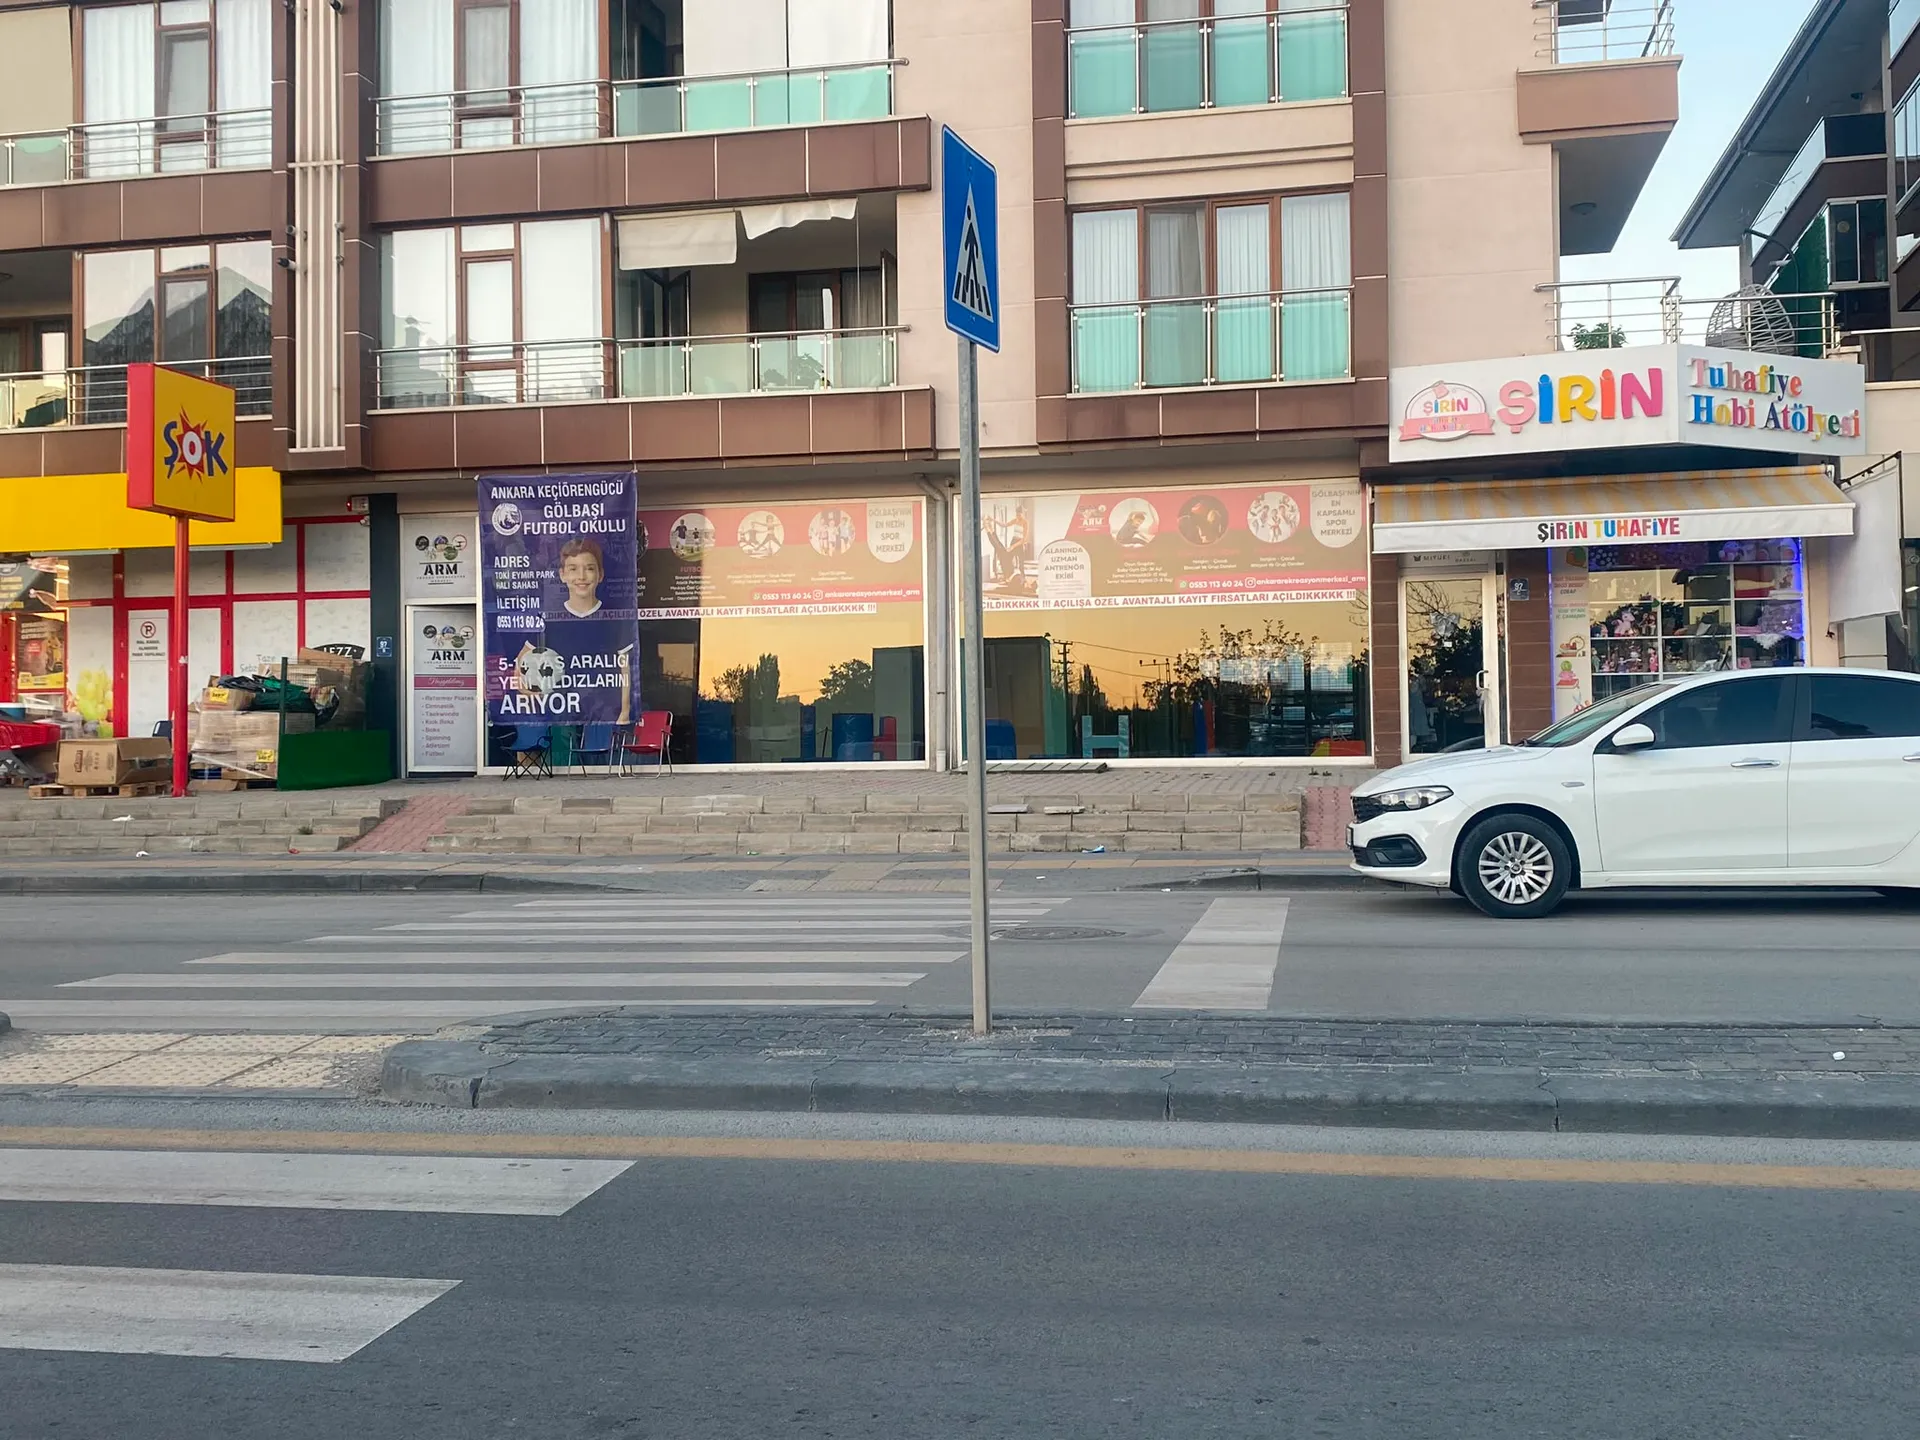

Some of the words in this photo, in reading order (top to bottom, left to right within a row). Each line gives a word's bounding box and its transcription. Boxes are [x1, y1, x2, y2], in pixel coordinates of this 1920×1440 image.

[1691, 357, 1802, 402] Tuhafiye
[1497, 368, 1663, 434] ŞİRİN
[1692, 393, 1756, 428] Hobi
[1763, 402, 1860, 441] Atölyesi
[163, 420, 228, 479] ŞOK
[491, 486, 535, 499] ANKARA
[538, 479, 624, 501] KEÇİÖRENGÜCÜ
[543, 501, 604, 521] GÖLBAŞI
[523, 521, 576, 535] FUTBOL
[580, 519, 626, 534] OKULU
[1321, 526, 1352, 536] MERKEZİ
[1537, 519, 1588, 543] ŞİRİN
[1594, 517, 1680, 539] TUHAFİYE
[880, 532, 900, 540] SPOR
[876, 543, 905, 552] MERKEZİ
[494, 556, 530, 568] ADRES
[424, 563, 458, 576] ARM
[511, 570, 535, 579] EYMİR
[536, 570, 555, 579] PARK
[512, 581, 539, 589] SAHASI
[1189, 581, 1208, 589] 0553
[1222, 580, 1233, 588] 60
[1233, 580, 1243, 588] 24
[497, 594, 540, 612] İLETİŞİM
[762, 593, 780, 601] 0553
[1053, 599, 1091, 609] AÇILIŞA
[1122, 596, 1175, 605] AVANTAJLI
[1178, 594, 1208, 604] KAYIT
[1211, 593, 1269, 603] FIRSATLARI
[1272, 591, 1344, 602] AÇILDIKKKKK
[665, 607, 714, 617] AVANTAJLI
[717, 606, 743, 616] KAYIT
[746, 606, 798, 615] FIRSATLARI
[801, 604, 865, 615] AÇILDIKKKKK
[497, 616, 512, 628] 0553
[512, 616, 524, 628] 113
[526, 616, 535, 628] 60
[431, 651, 465, 661] ARM
[240, 664, 258, 672] Sebz
[500, 693, 581, 715] ARIYOR
